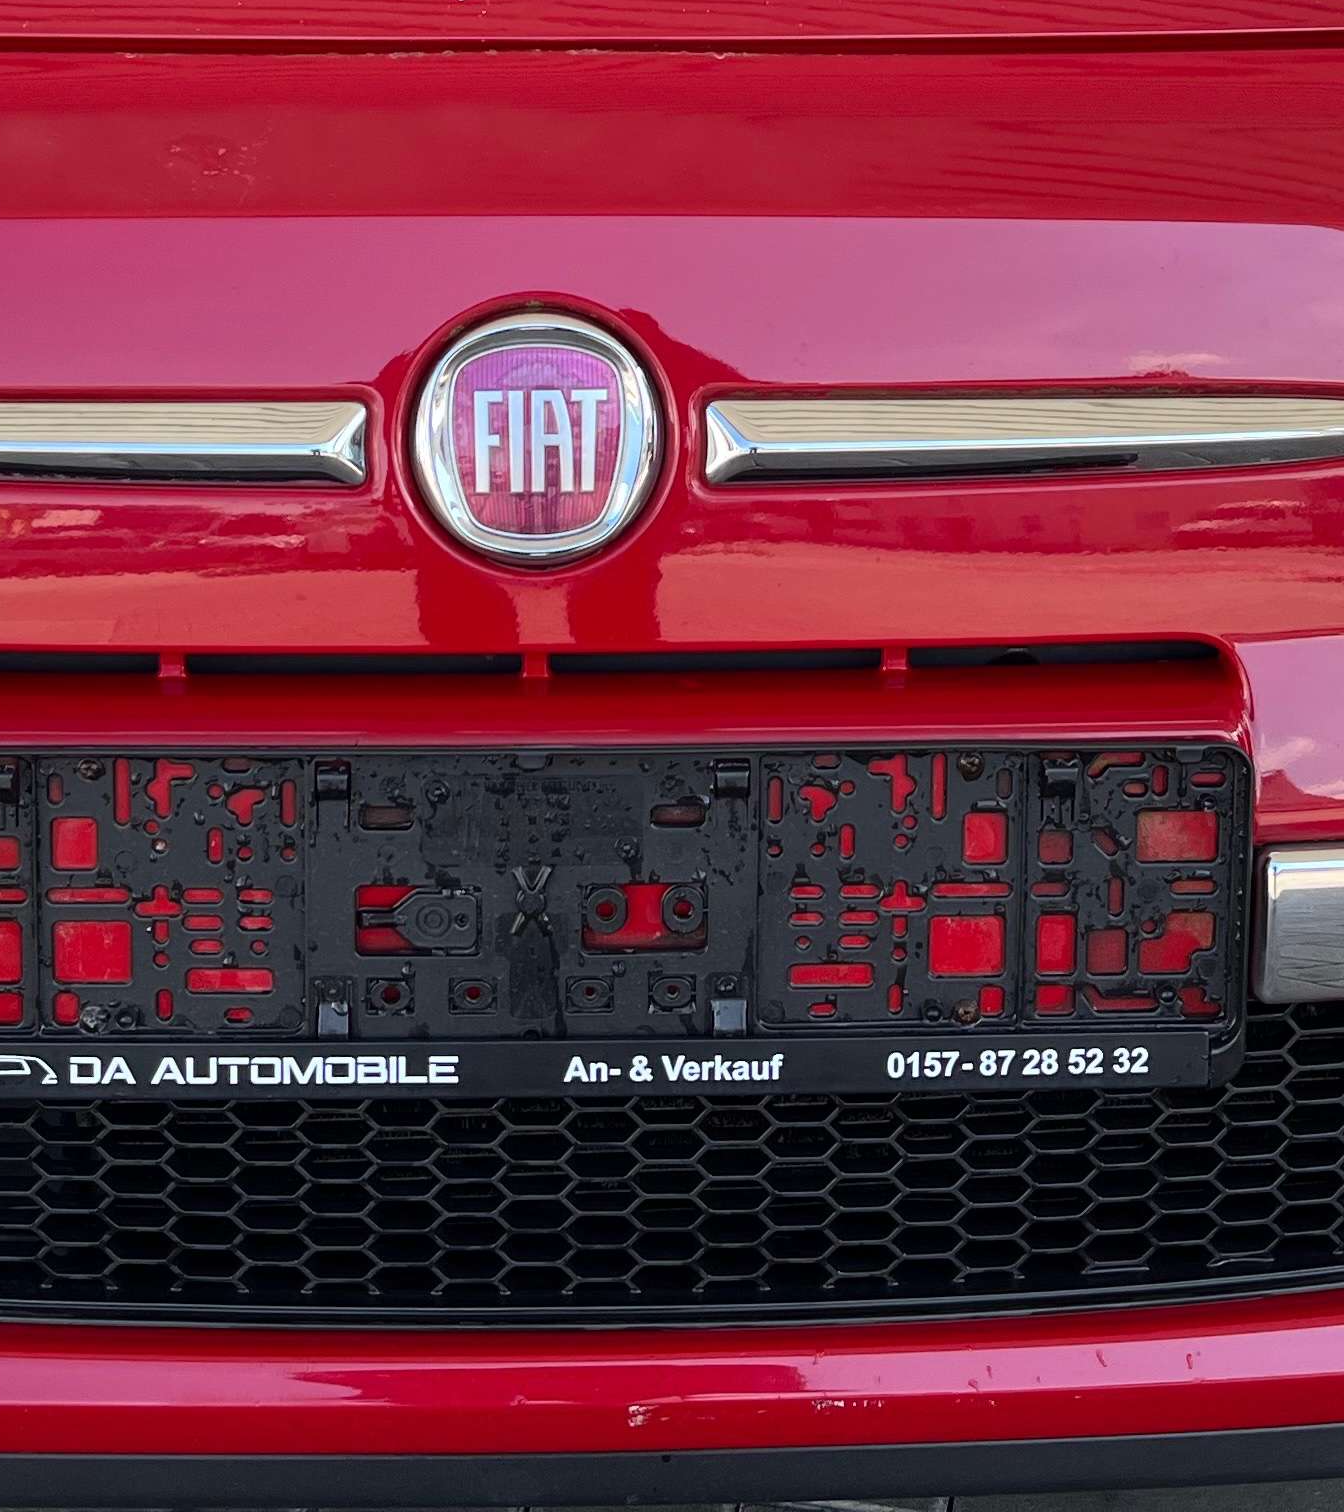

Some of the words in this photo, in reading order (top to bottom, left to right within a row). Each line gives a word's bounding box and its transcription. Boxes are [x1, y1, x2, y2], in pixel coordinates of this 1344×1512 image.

[473, 389, 608, 494] FIAT
[69, 1056, 136, 1085] DA
[151, 1055, 459, 1085] AUTOMOBILE
[563, 1055, 622, 1083] An-
[629, 1055, 654, 1082] &
[661, 1053, 784, 1082] Verkauf
[979, 1049, 1016, 1077] 87
[1022, 1048, 1059, 1076] 28
[1067, 1047, 1104, 1074] 52
[1112, 1046, 1149, 1074] 32
